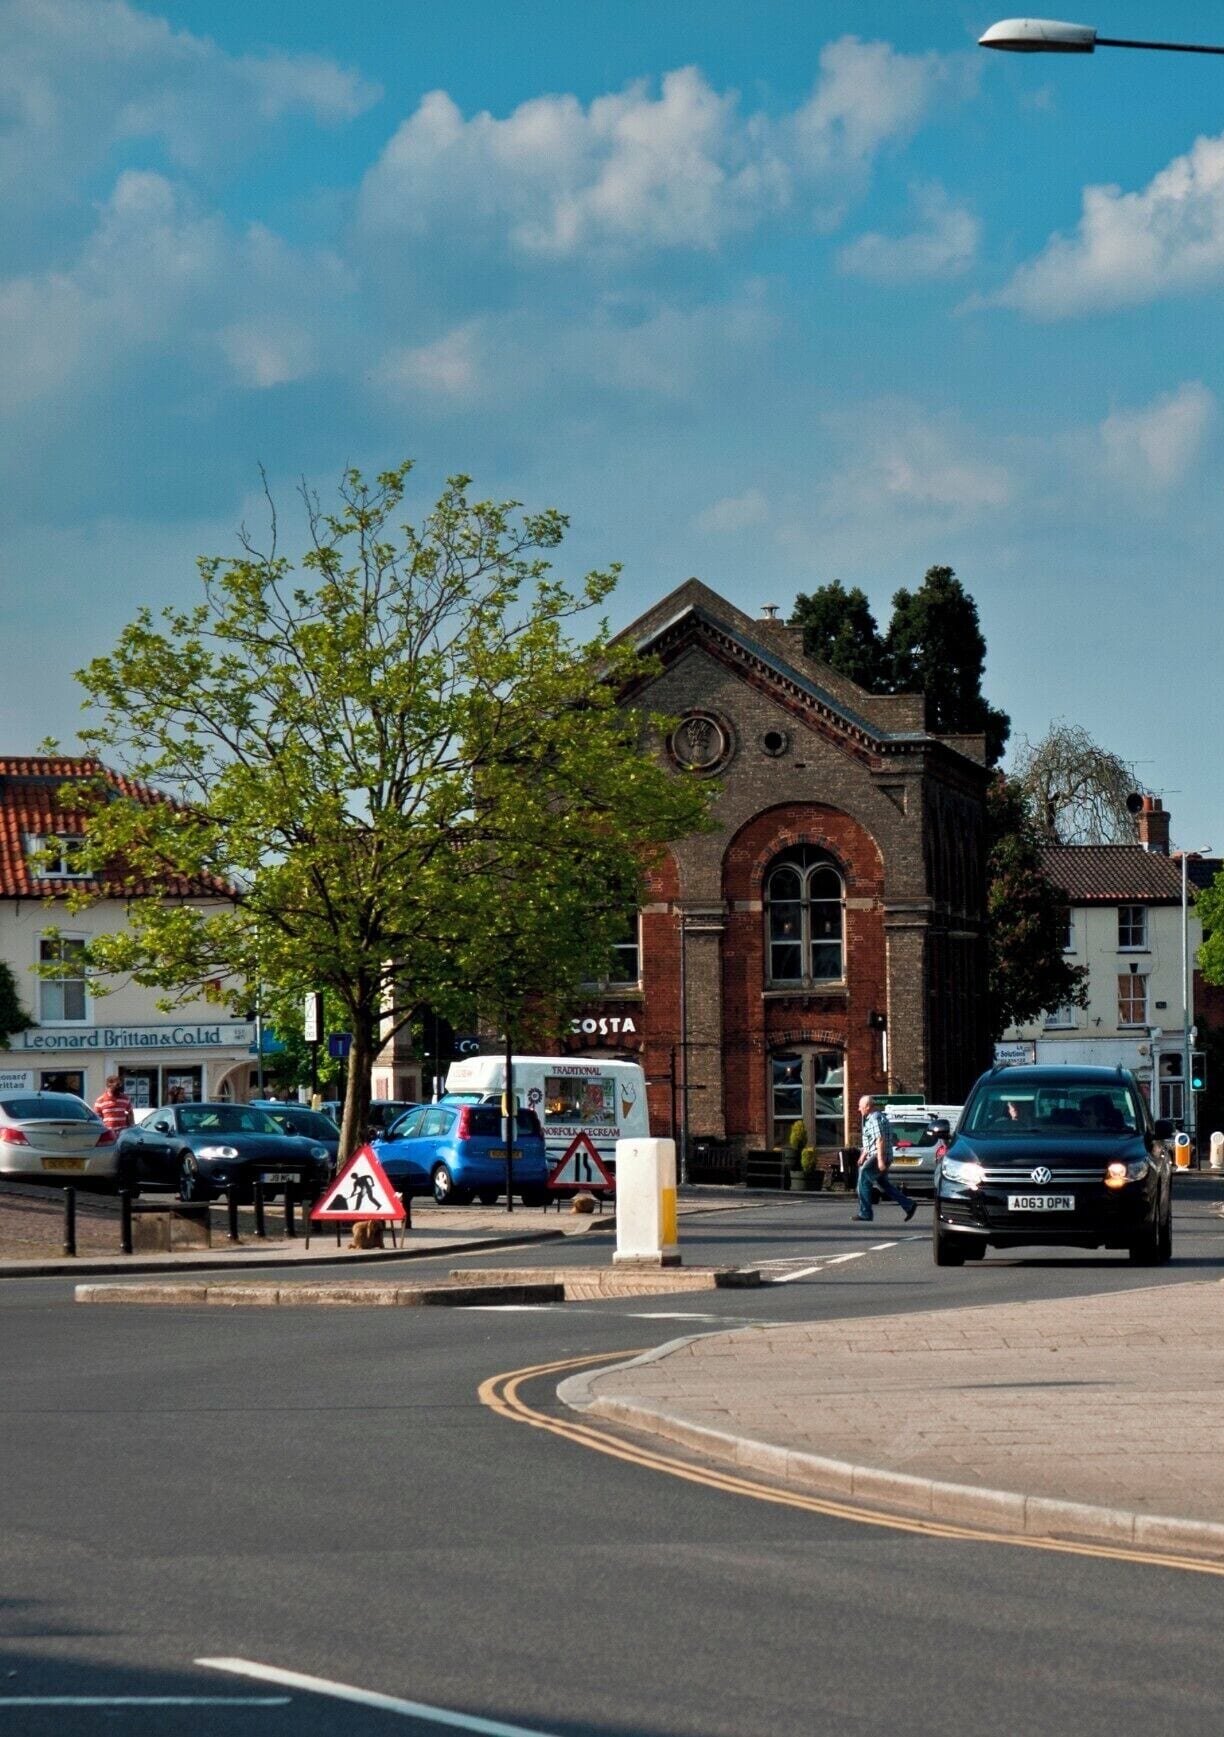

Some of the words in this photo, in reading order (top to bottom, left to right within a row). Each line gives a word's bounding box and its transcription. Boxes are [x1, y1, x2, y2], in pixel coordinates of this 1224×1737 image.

[571, 1017, 636, 1035] COSTA
[24, 1030, 98, 1048] Leonard
[104, 1029, 158, 1046] Brittan
[552, 1066, 601, 1075] TRADITIONAL
[542, 1127, 578, 1137] NORFOLK
